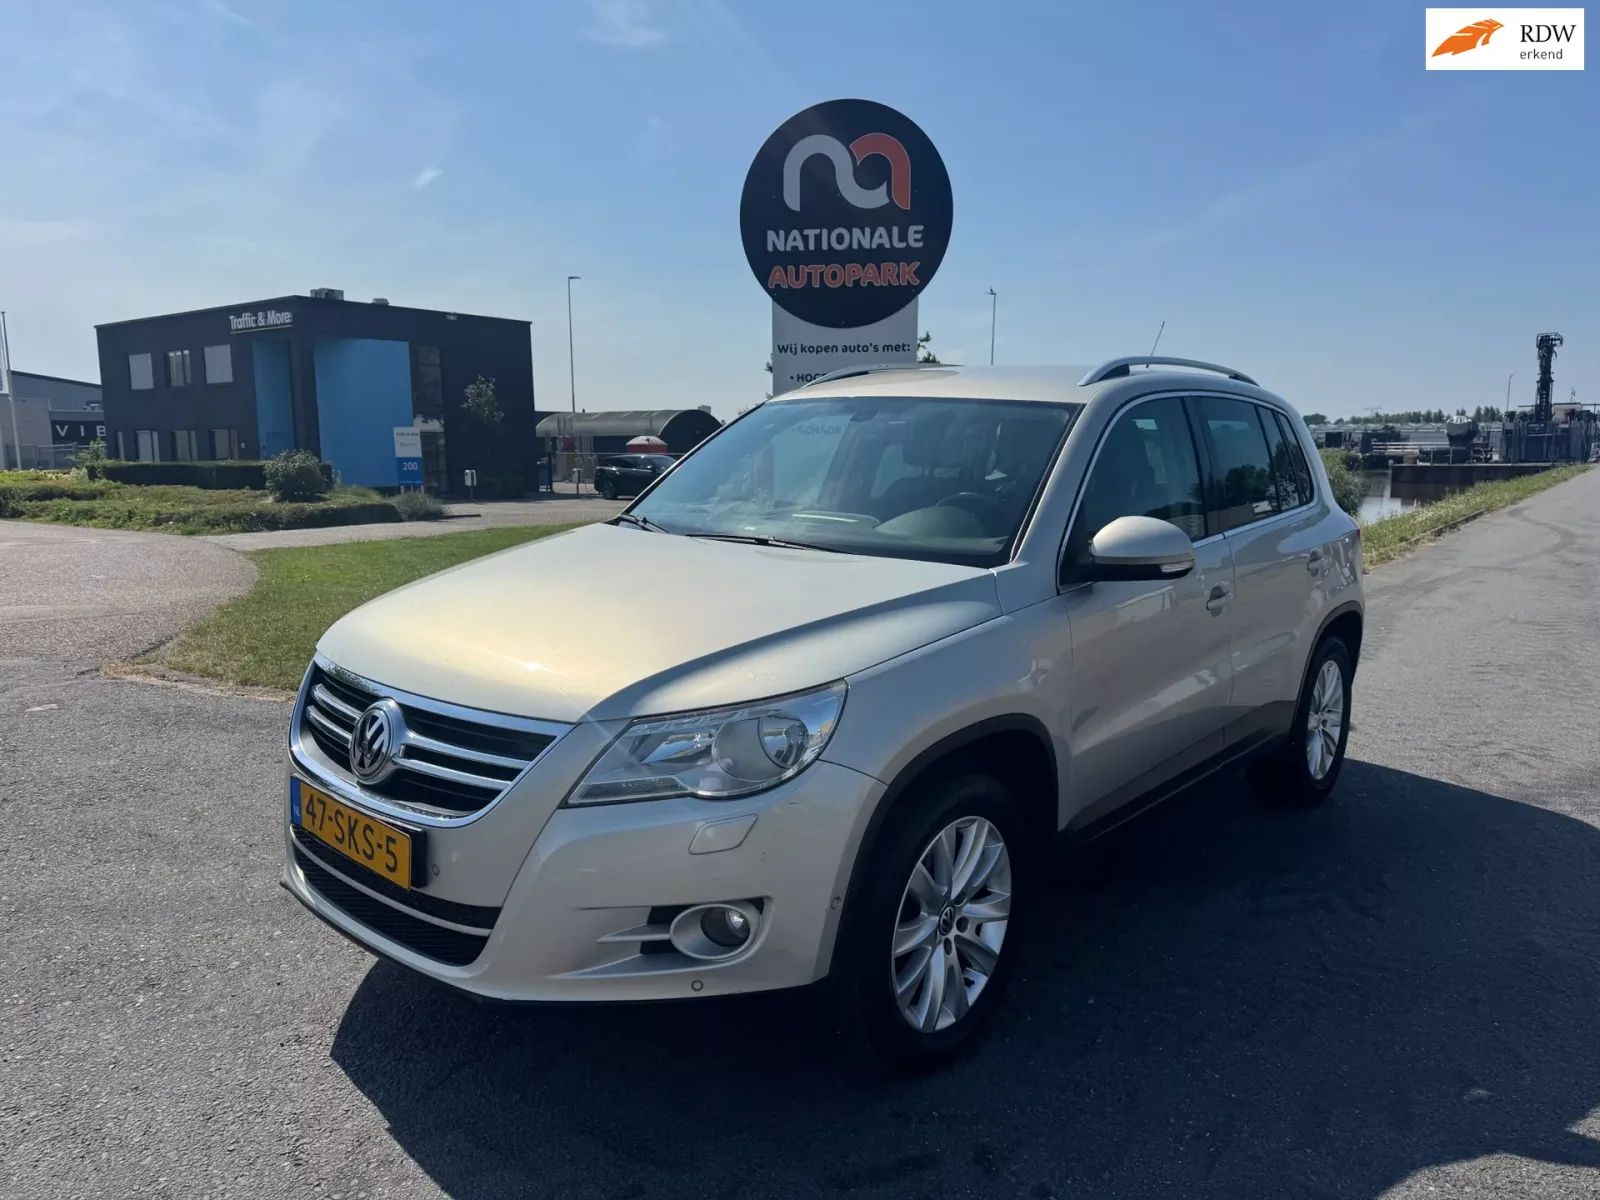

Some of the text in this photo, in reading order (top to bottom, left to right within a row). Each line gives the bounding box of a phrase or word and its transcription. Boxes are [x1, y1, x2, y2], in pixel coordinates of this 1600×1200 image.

[766, 225, 925, 252] NATIONALE
[768, 261, 921, 289] AUTOPARK
[228, 312, 257, 330] Traffic
[257, 311, 266, 326] &
[777, 342, 911, 355] Wij kopen auto's met:
[402, 461, 418, 471] 200
[305, 793, 398, 873] 47-SKS-5
